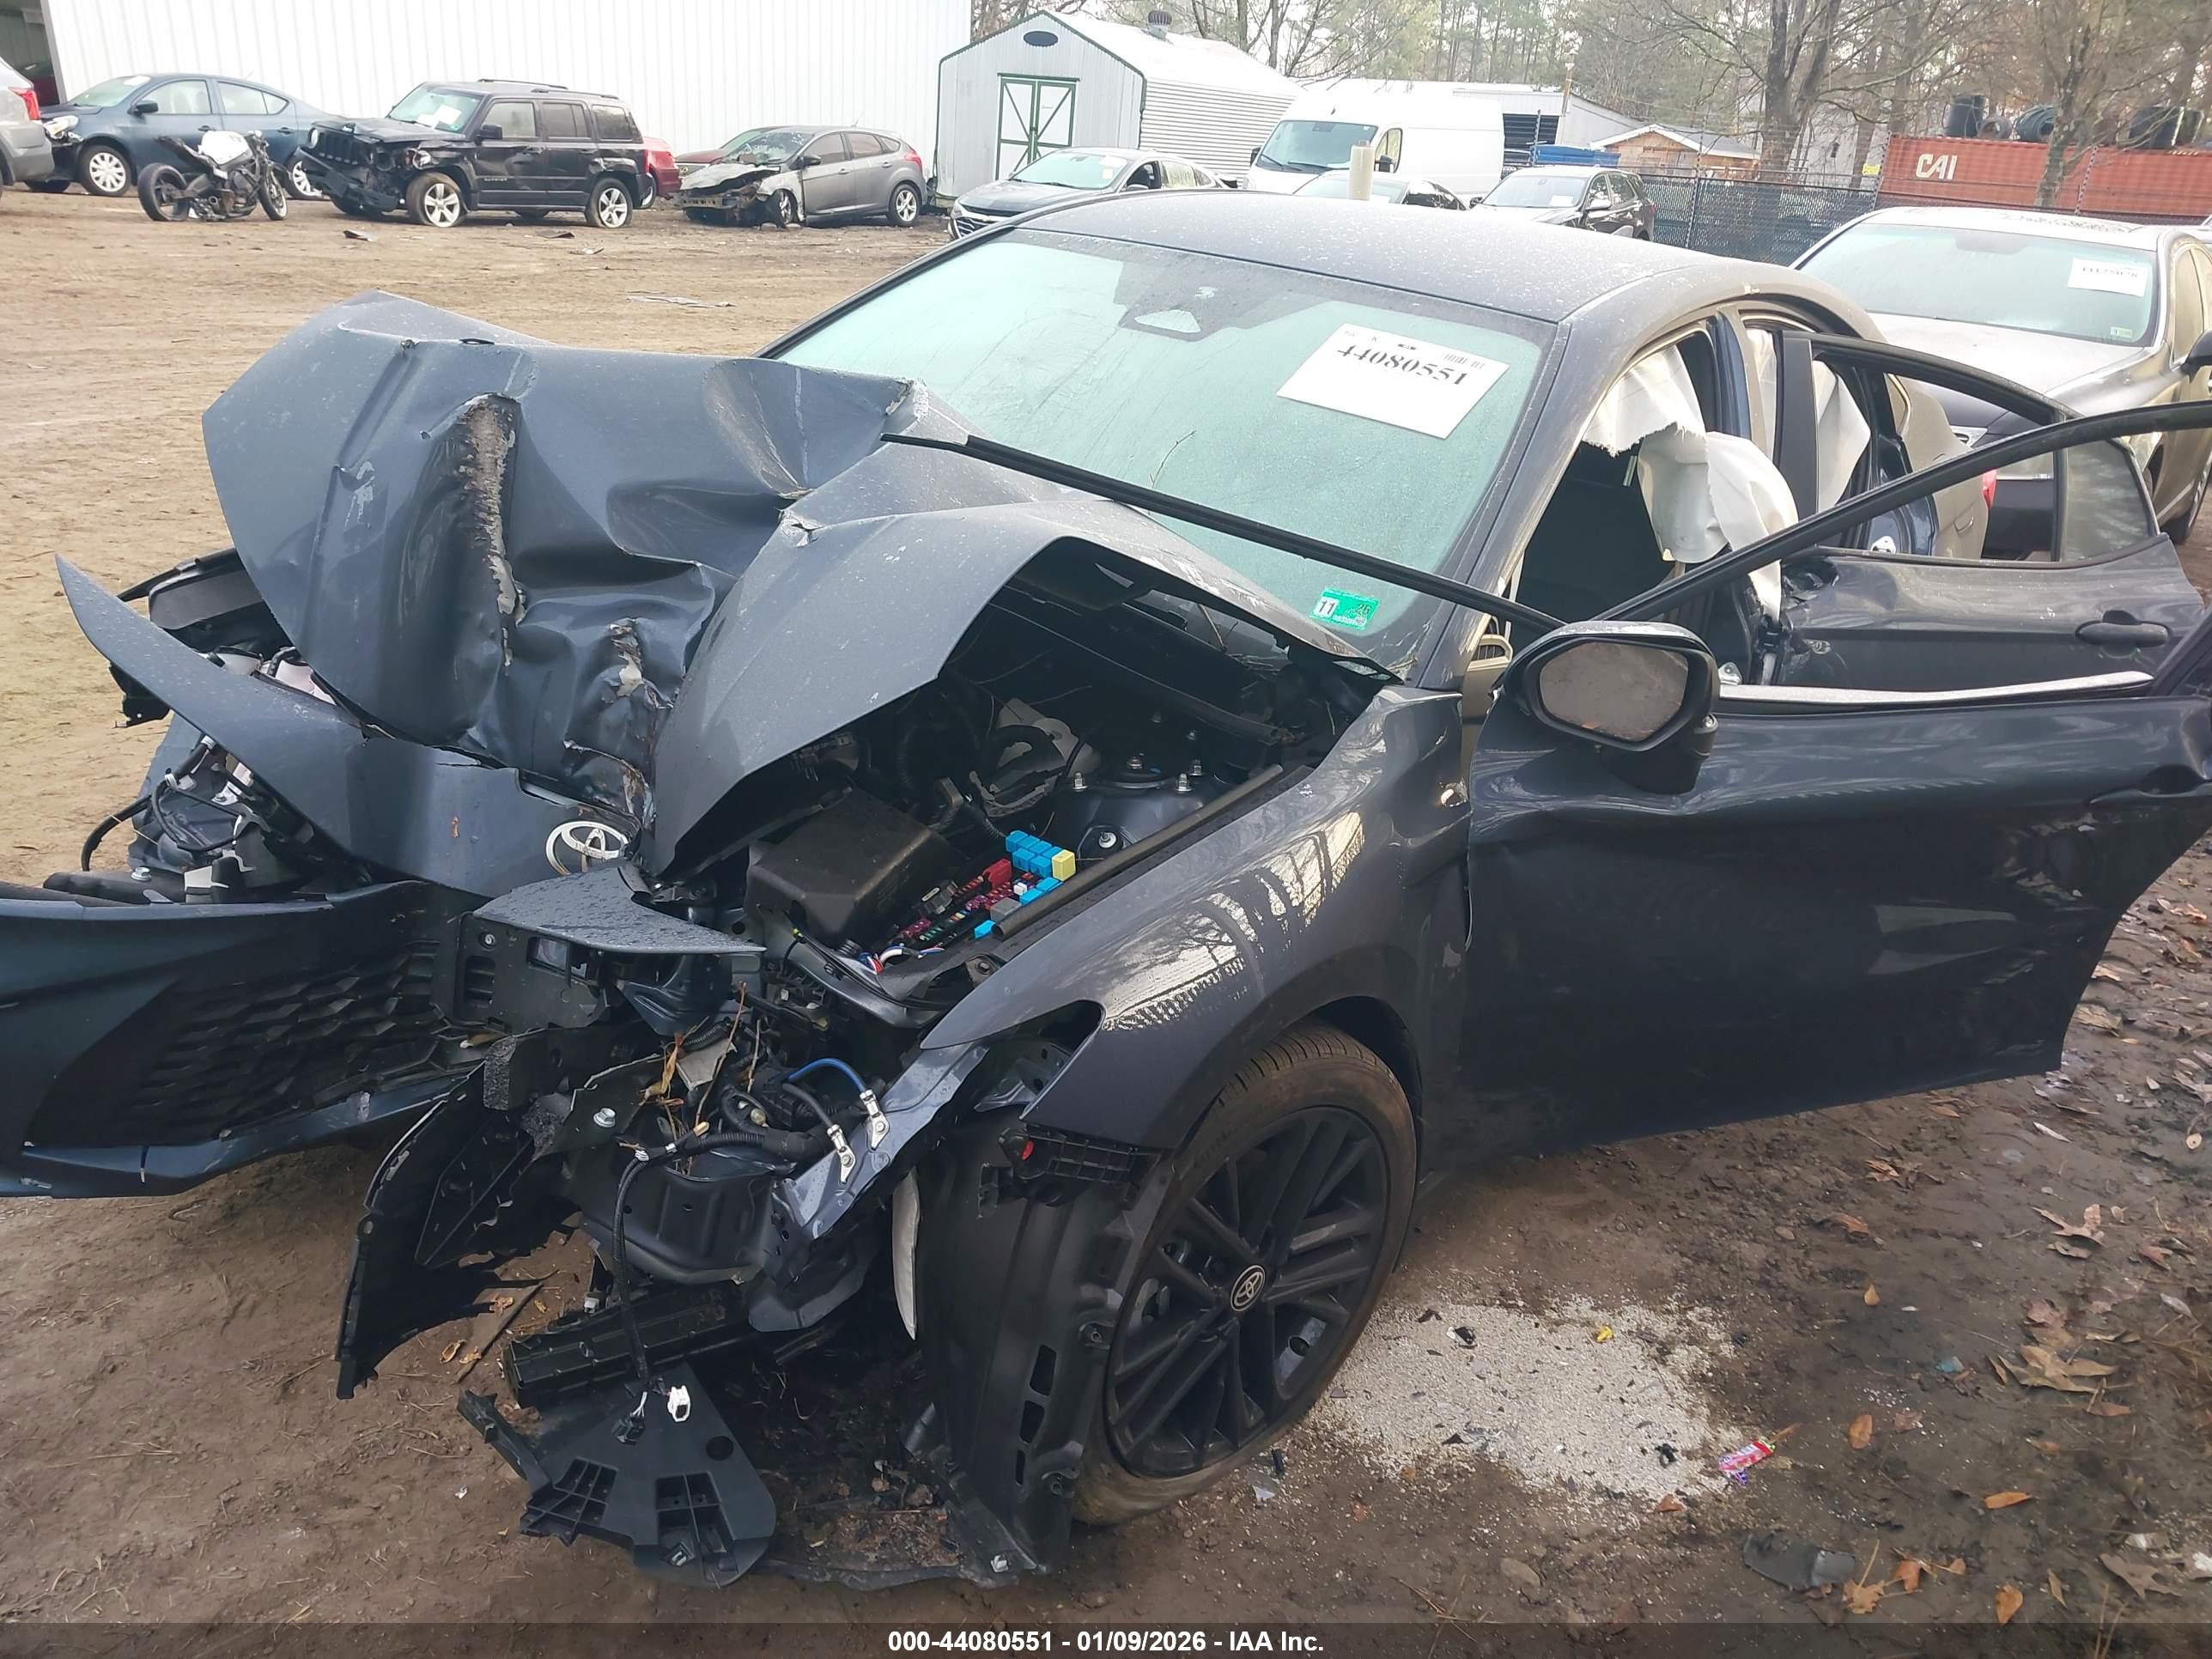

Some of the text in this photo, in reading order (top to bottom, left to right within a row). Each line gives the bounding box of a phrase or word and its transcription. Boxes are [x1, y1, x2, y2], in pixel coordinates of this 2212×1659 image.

[1916, 154, 1958, 179] CAI
[1337, 344, 1468, 386] 44080551
[1318, 600, 1335, 615] 11
